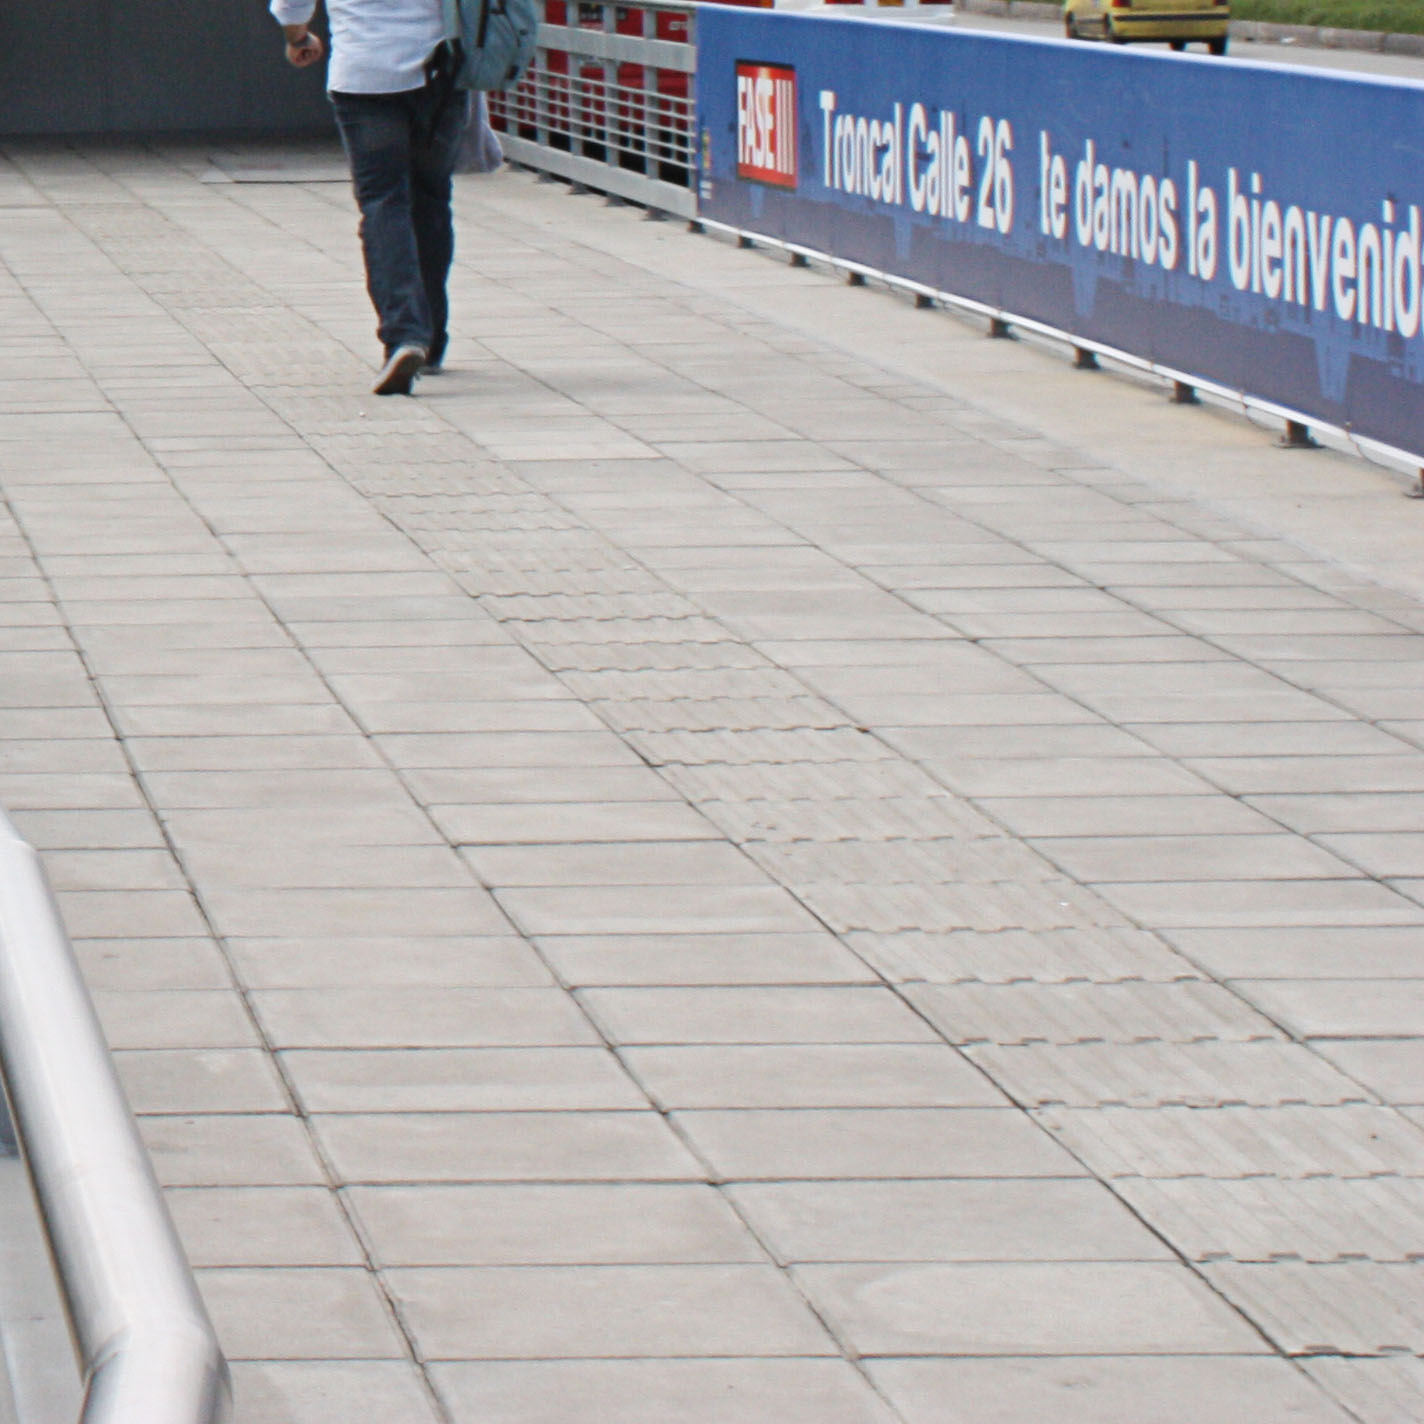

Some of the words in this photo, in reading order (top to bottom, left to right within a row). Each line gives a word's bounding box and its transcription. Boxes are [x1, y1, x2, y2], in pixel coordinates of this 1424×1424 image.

[737, 74, 775, 171] FASE
[819, 89, 903, 206] Troncal
[907, 102, 972, 224] Calle
[977, 115, 1014, 236] 26
[1040, 129, 1069, 241] te
[1075, 138, 1179, 272] damos
[1188, 159, 1219, 282] la
[1228, 167, 1424, 340] bienvenid
